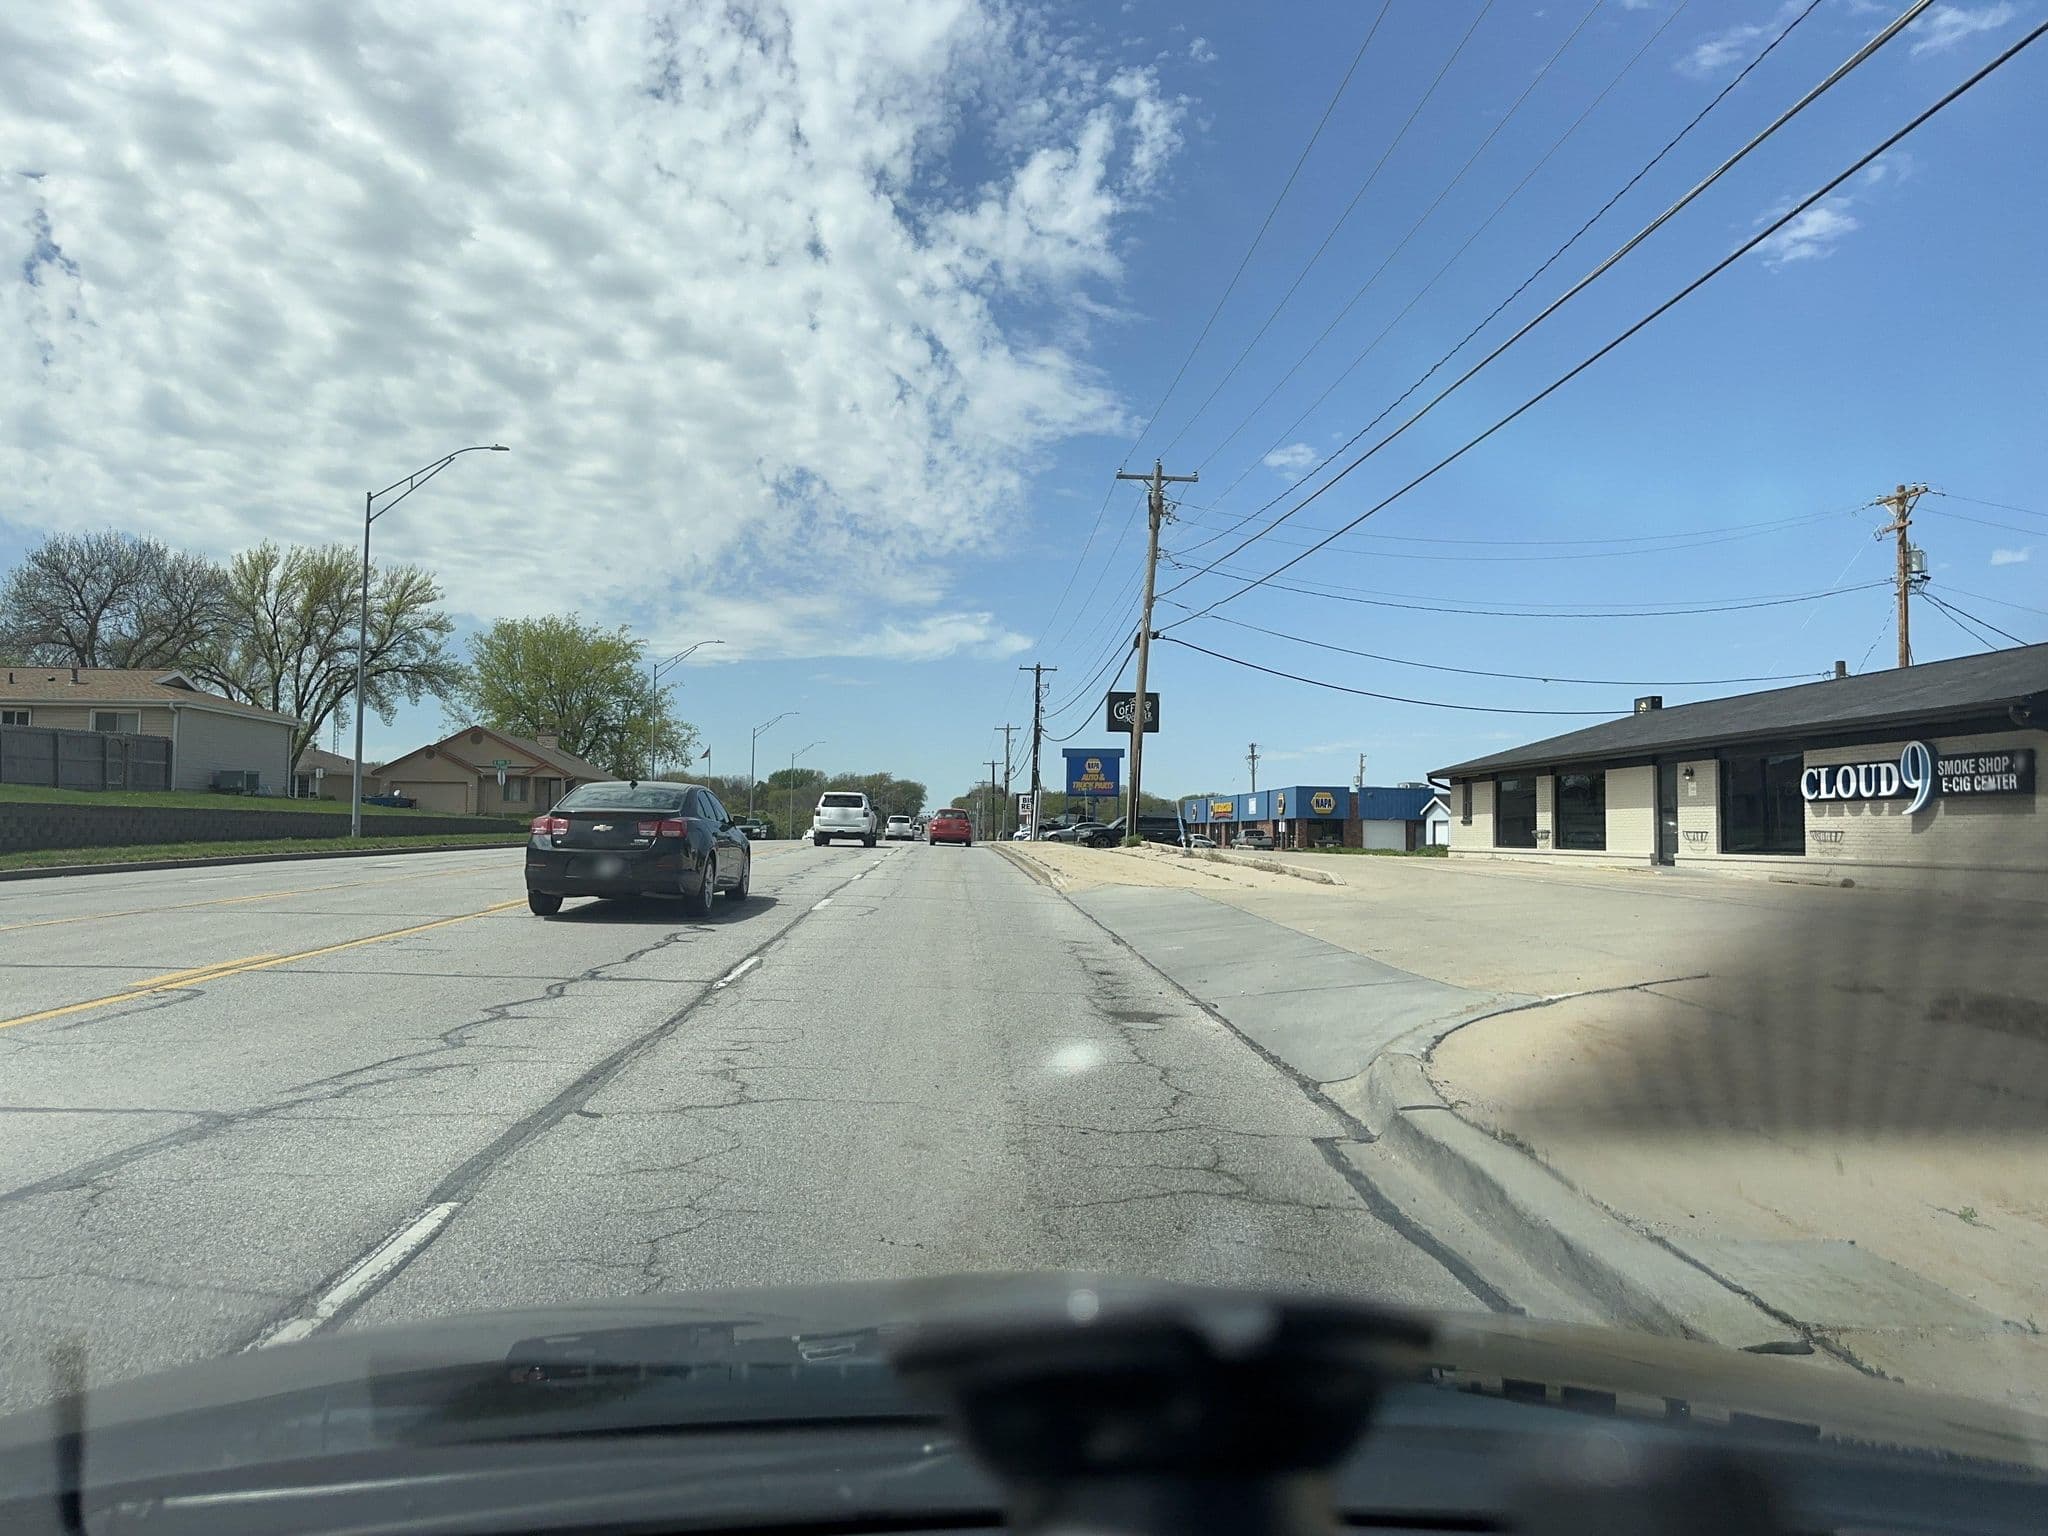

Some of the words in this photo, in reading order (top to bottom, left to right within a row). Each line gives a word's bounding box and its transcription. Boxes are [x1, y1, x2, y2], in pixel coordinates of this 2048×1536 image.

[1937, 758, 1976, 776] SMOKE
[1978, 756, 2010, 774] SHOP
[1801, 763, 1900, 800] CLOUD
[1901, 740, 1932, 815] 9
[1942, 775, 1971, 792] E-CIG
[1315, 798, 1332, 808] NAPA
